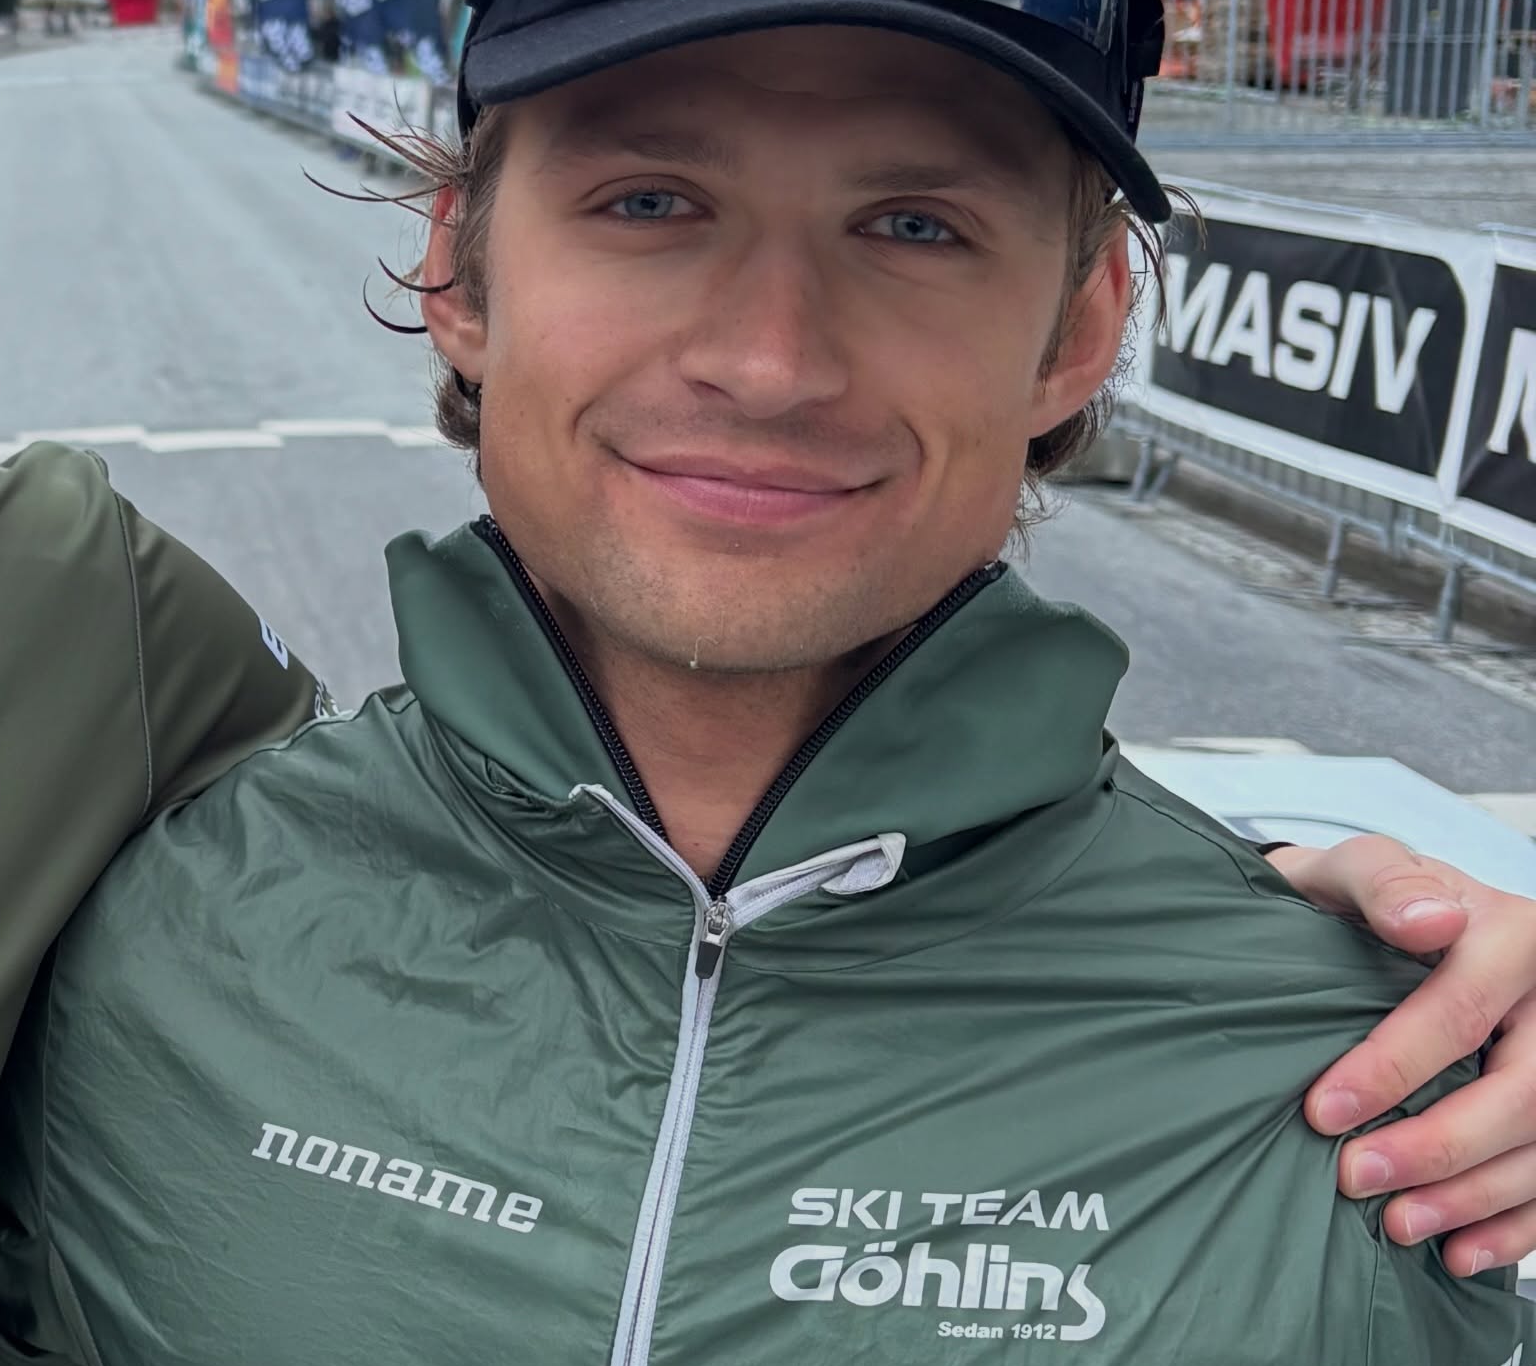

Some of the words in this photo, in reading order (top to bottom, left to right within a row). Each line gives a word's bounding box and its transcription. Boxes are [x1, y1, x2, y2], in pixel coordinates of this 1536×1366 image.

[1157, 253, 1436, 414] MASIV
[251, 1122, 544, 1234] noname
[788, 1187, 903, 1231] SKI
[921, 1189, 1110, 1232] TEAM
[769, 1241, 1107, 1342] Göhlins
[937, 1321, 1004, 1340] Sedan
[1011, 1322, 1057, 1341] 1912
